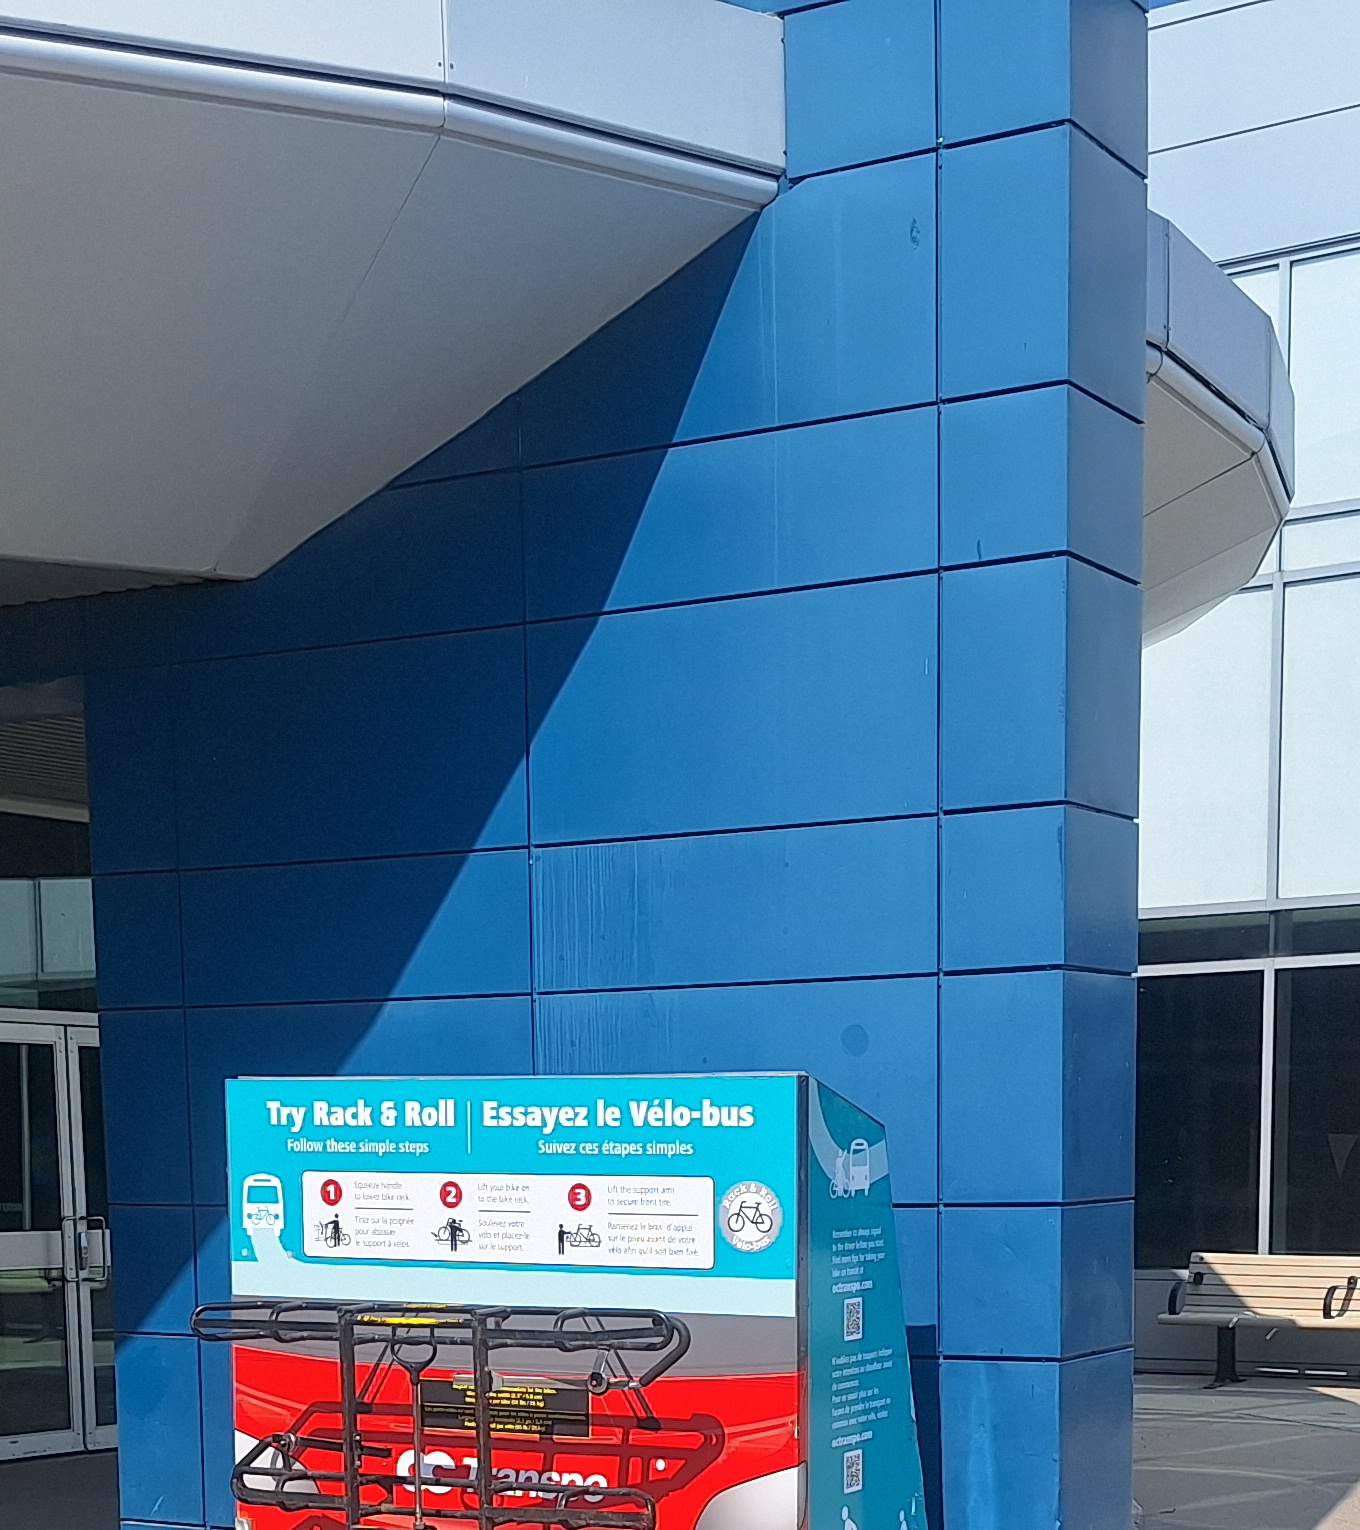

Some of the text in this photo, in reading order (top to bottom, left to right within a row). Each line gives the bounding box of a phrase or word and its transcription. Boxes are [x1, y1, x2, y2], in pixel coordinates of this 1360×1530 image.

[266, 1098, 456, 1133] Try Rack & Roll
[482, 1098, 755, 1134] Essayez le Vélo-bus
[287, 1137, 430, 1157] Follow these simple steps
[538, 1139, 694, 1158] Suivez ces étapes simples
[326, 1185, 337, 1200] 1
[446, 1186, 457, 1203] 2
[574, 1188, 587, 1205] 3
[620, 1185, 631, 1194] the
[722, 1183, 778, 1211] Rack & Roll
